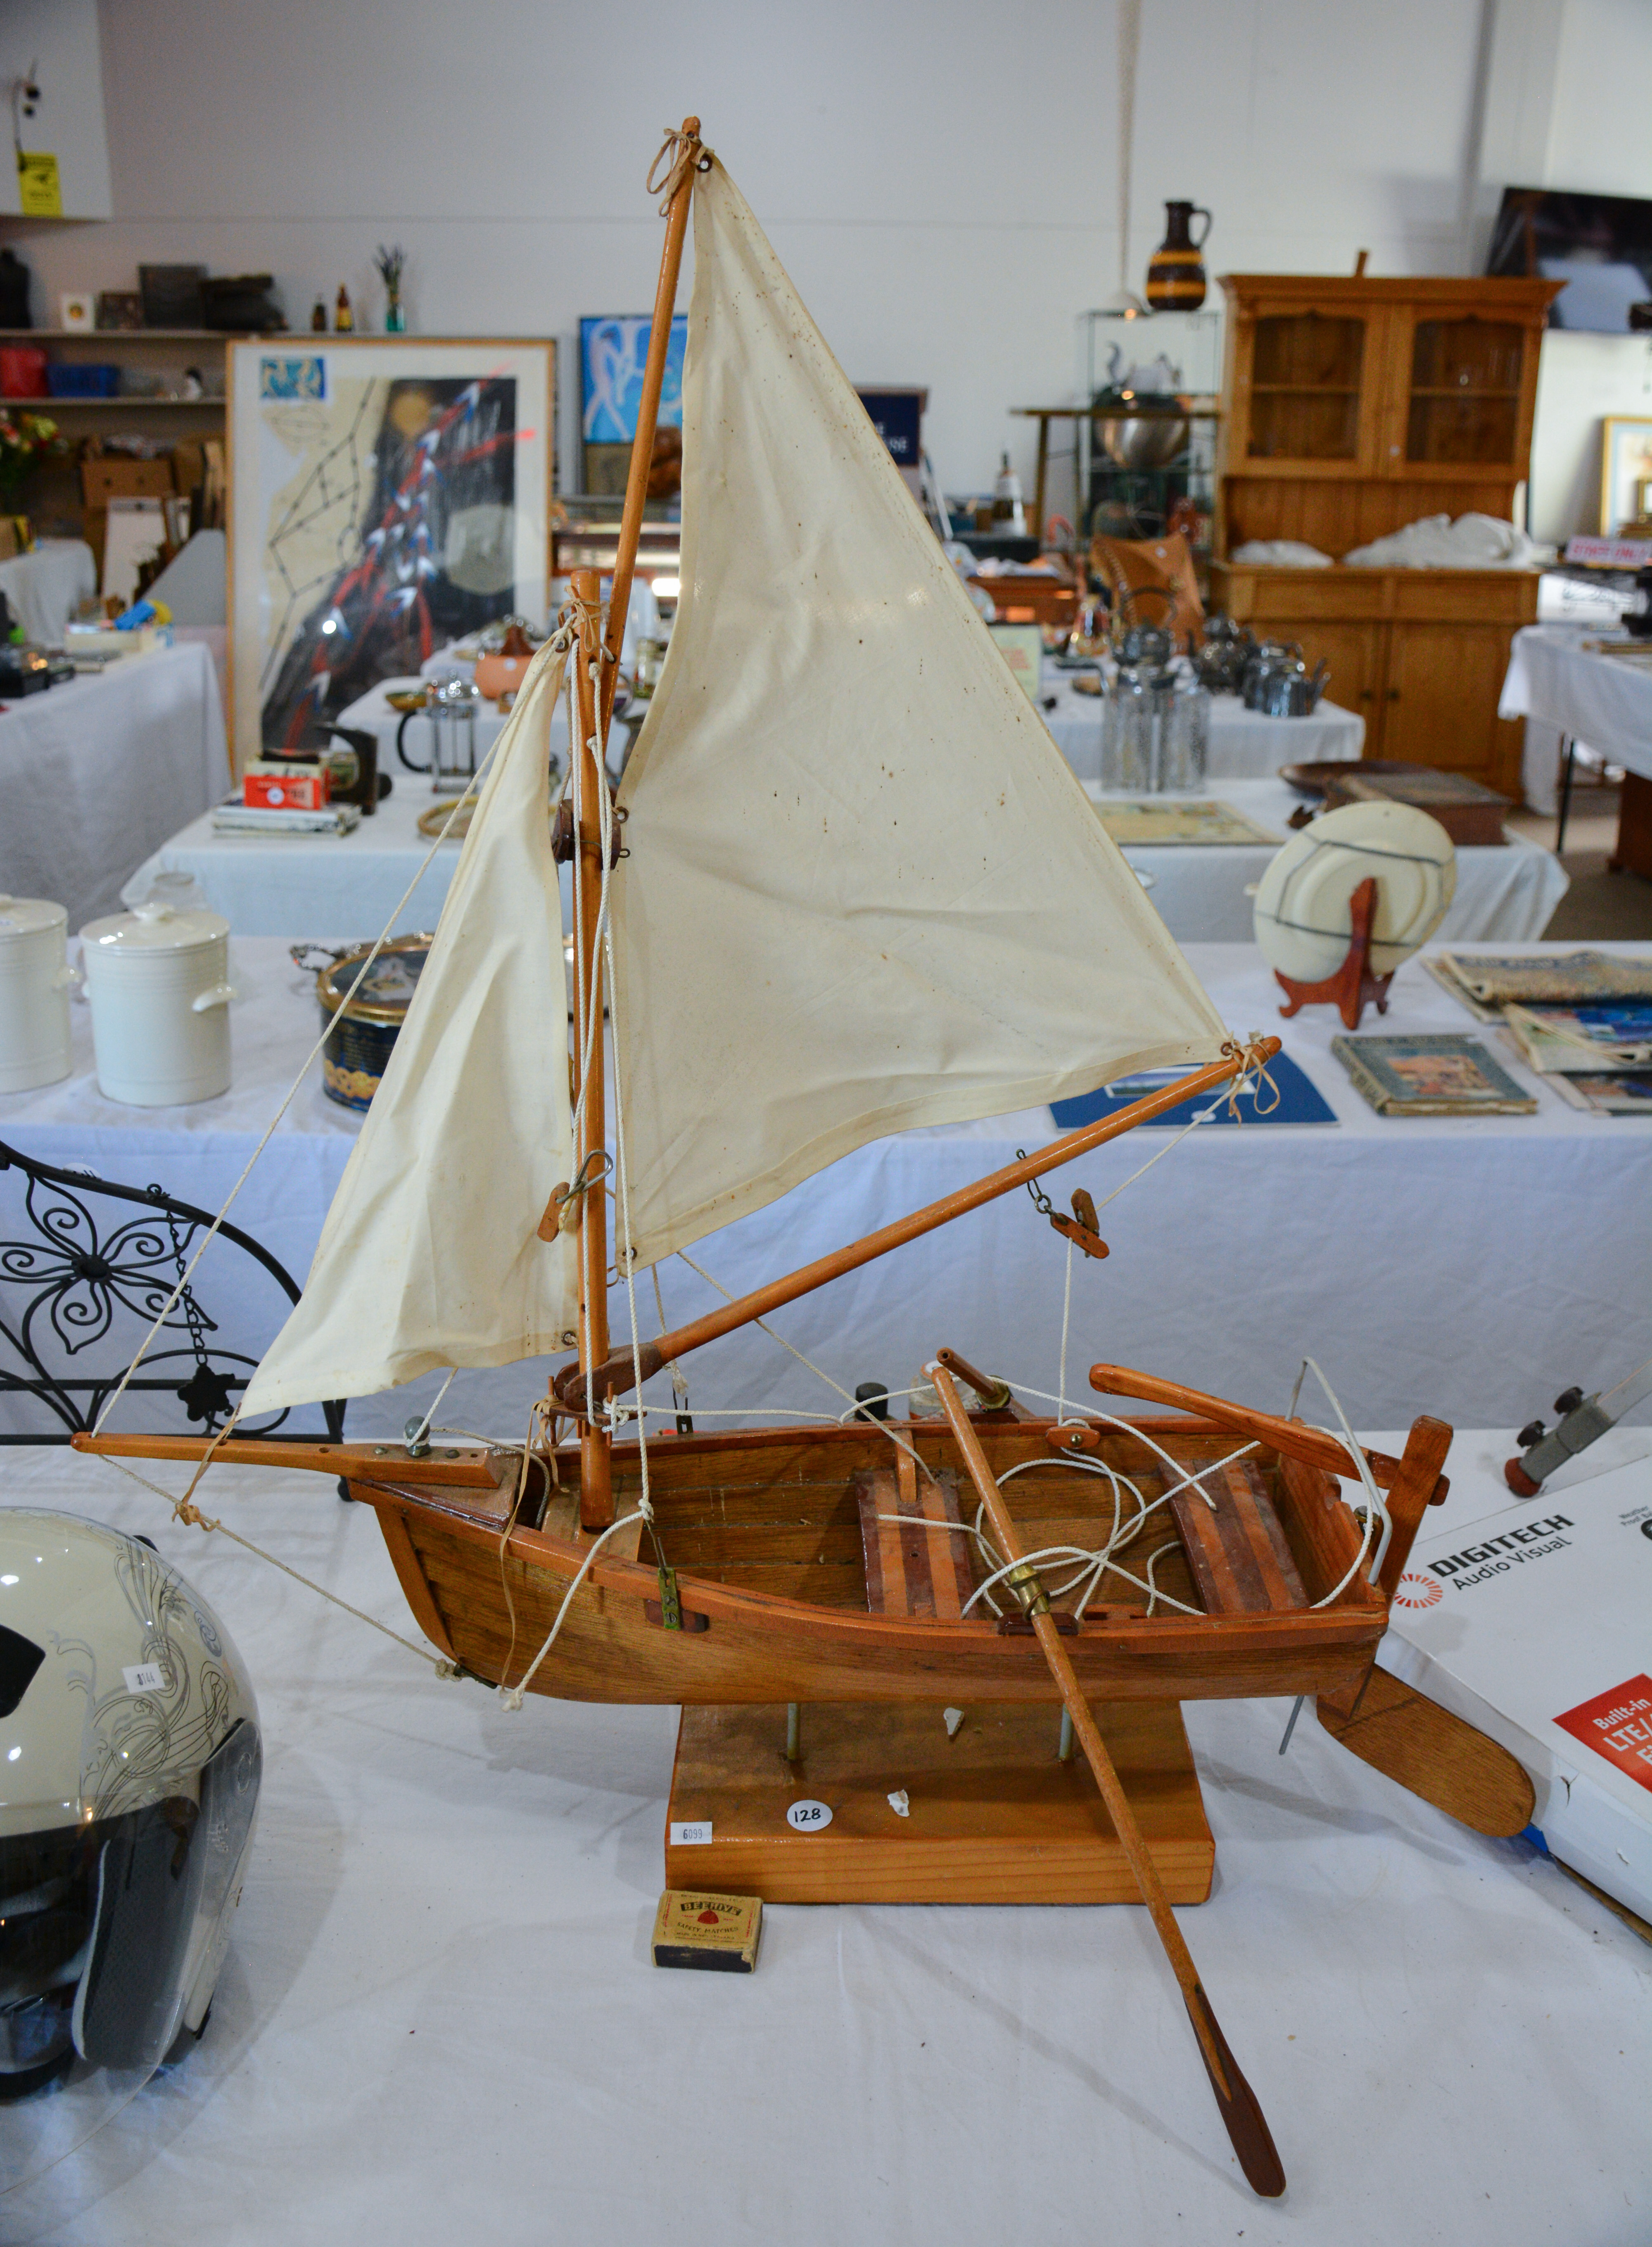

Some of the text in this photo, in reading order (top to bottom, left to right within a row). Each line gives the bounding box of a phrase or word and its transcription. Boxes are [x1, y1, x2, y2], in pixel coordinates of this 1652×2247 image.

[1427, 1515, 1575, 1577] DIGITECH
[1453, 1536, 1572, 1590] Audio Visual
[1593, 1699, 1651, 1729] Built-in
[1603, 1714, 1652, 1751] LTE/
[795, 1808, 821, 1822] 128
[683, 1829, 703, 1839] 6099
[684, 1902, 741, 1915] BEEHIVE
[677, 1922, 701, 1932] SAFETY
